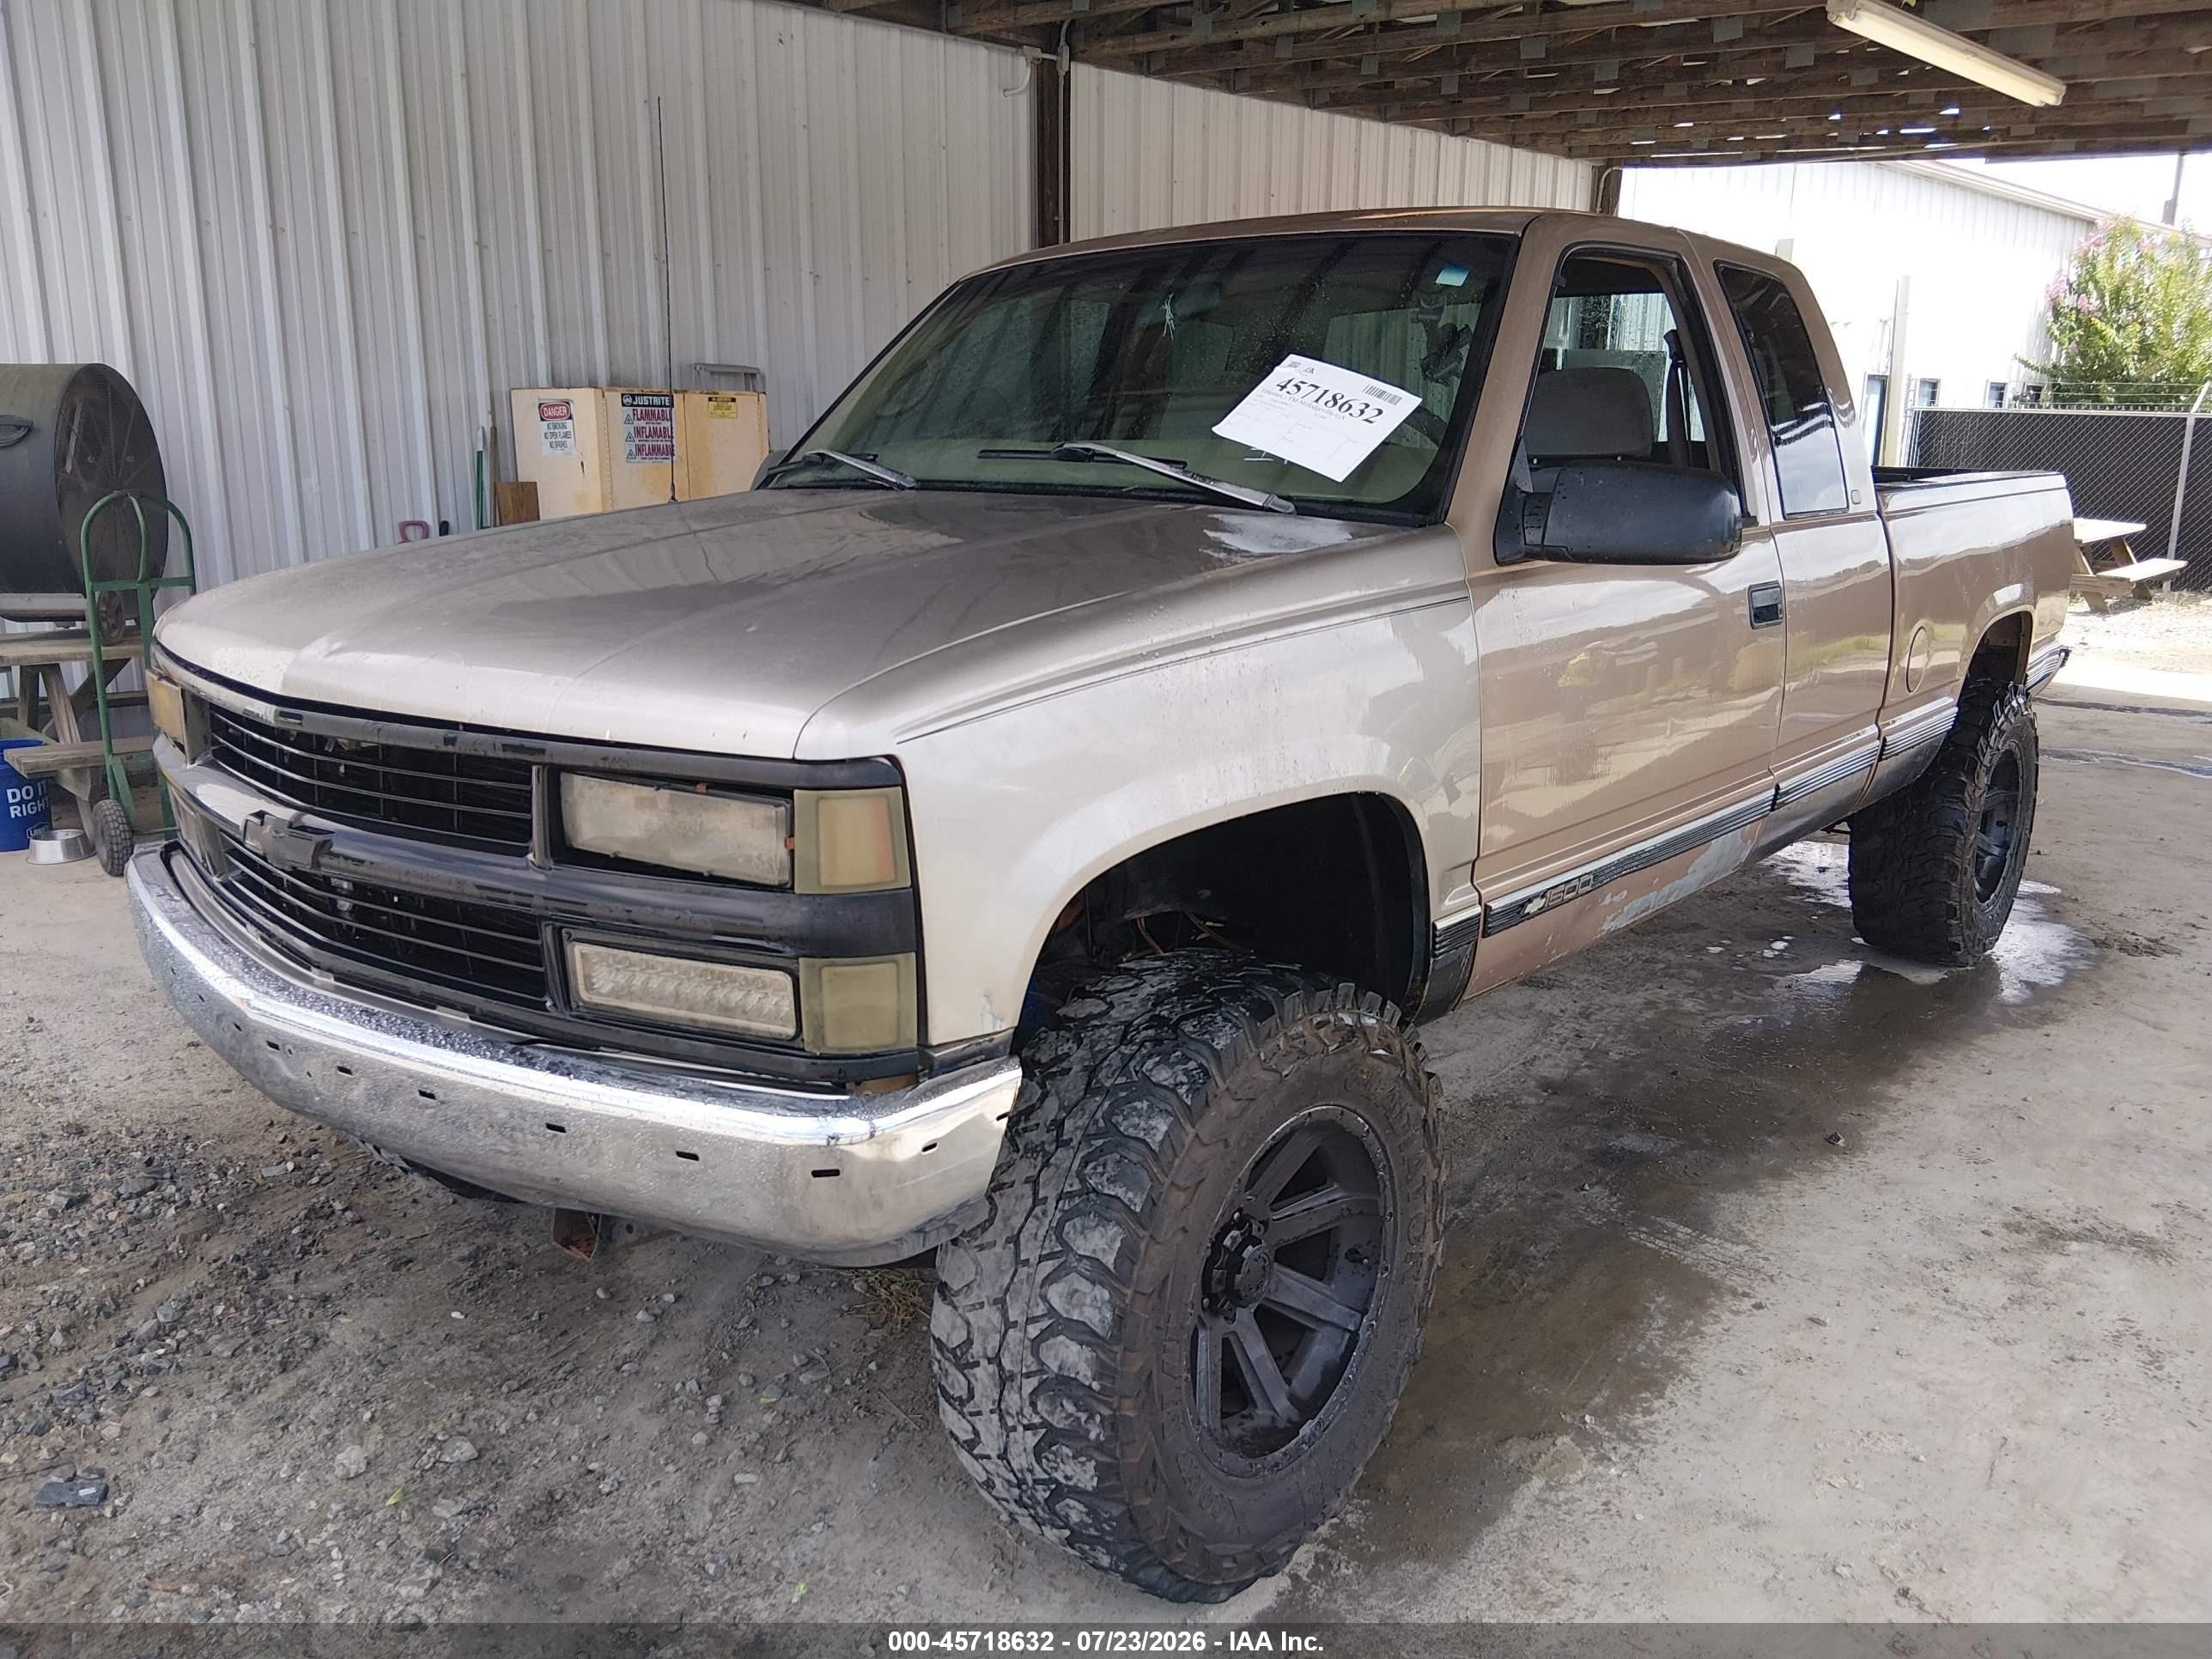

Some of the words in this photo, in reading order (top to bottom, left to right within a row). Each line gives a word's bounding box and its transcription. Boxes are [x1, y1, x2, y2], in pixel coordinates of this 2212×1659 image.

[632, 395, 671, 406] JUSTRITE
[1276, 377, 1384, 425] 45718632
[543, 405, 568, 417] DANGER
[7, 785, 33, 804] DO
[37, 781, 48, 796] IT
